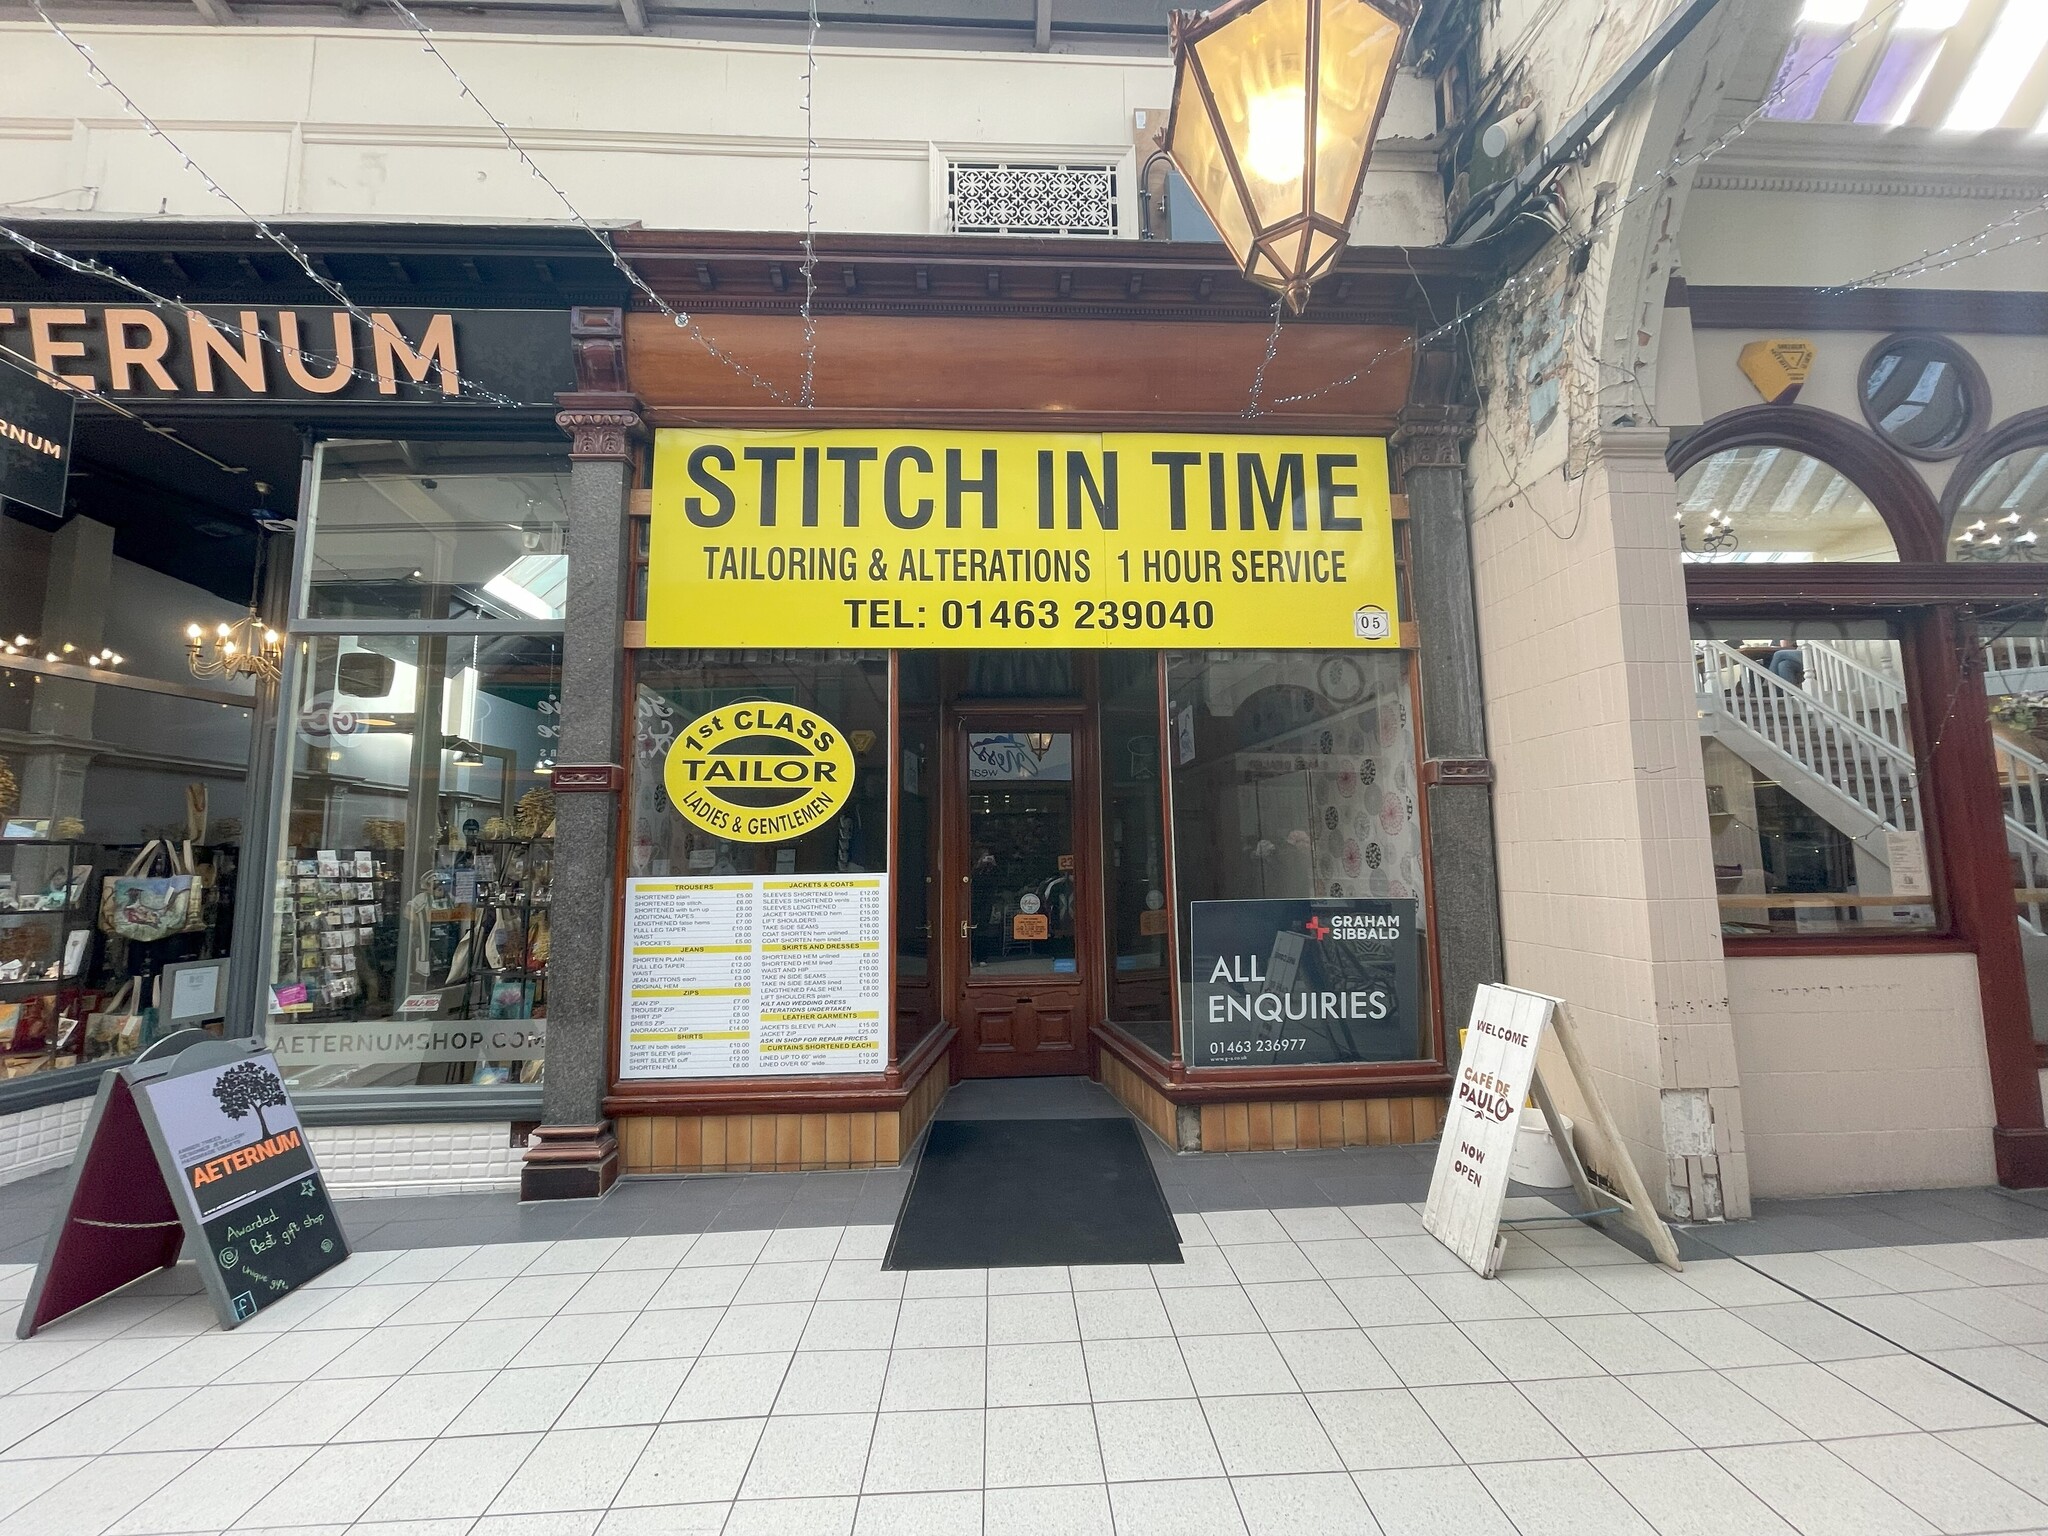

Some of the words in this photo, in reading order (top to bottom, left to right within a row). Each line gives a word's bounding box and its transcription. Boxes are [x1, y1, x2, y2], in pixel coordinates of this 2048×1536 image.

[684, 445, 998, 529] STITCH
[1038, 450, 1118, 530] IN
[1152, 452, 1363, 531] TIME
[703, 547, 856, 581] TAILORING
[868, 548, 888, 581] &
[899, 549, 1090, 582] ALTERATIONS
[1118, 550, 1130, 582] 1
[1144, 550, 1222, 582] HOUR
[1232, 550, 1347, 582] SERVICE
[844, 599, 926, 629] TEL:
[942, 600, 1059, 629] 01463
[1075, 600, 1214, 629] 239040
[685, 715, 724, 751] 1st
[734, 710, 834, 752] CLASS
[682, 760, 837, 782] TAILOR
[683, 790, 730, 829] LADIES
[732, 817, 742, 833] &
[747, 791, 834, 834] GENTLEMEN
[1331, 916, 1399, 927] GRAHAM
[1333, 928, 1399, 940] SIBBALD
[1209, 955, 1266, 984] ALL
[1209, 991, 1387, 1023] ENQUIRIES
[275, 1031, 546, 1054] AETERNUMSHOP.COM
[1210, 1041, 1251, 1054] 01463
[1256, 1039, 1306, 1052] 236977
[1477, 1020, 1529, 1048] WELCOME
[1464, 1067, 1494, 1088] CAFÉ
[1495, 1079, 1510, 1095] DE
[1459, 1082, 1514, 1122] PAULO
[194, 1130, 301, 1188] AETERNUM
[1460, 1141, 1485, 1164] NOW
[1454, 1160, 1482, 1188] OPEN
[228, 1208, 279, 1242] Awarded
[250, 1231, 276, 1255] Best
[282, 1222, 300, 1245] gift
[303, 1213, 324, 1228] shop
